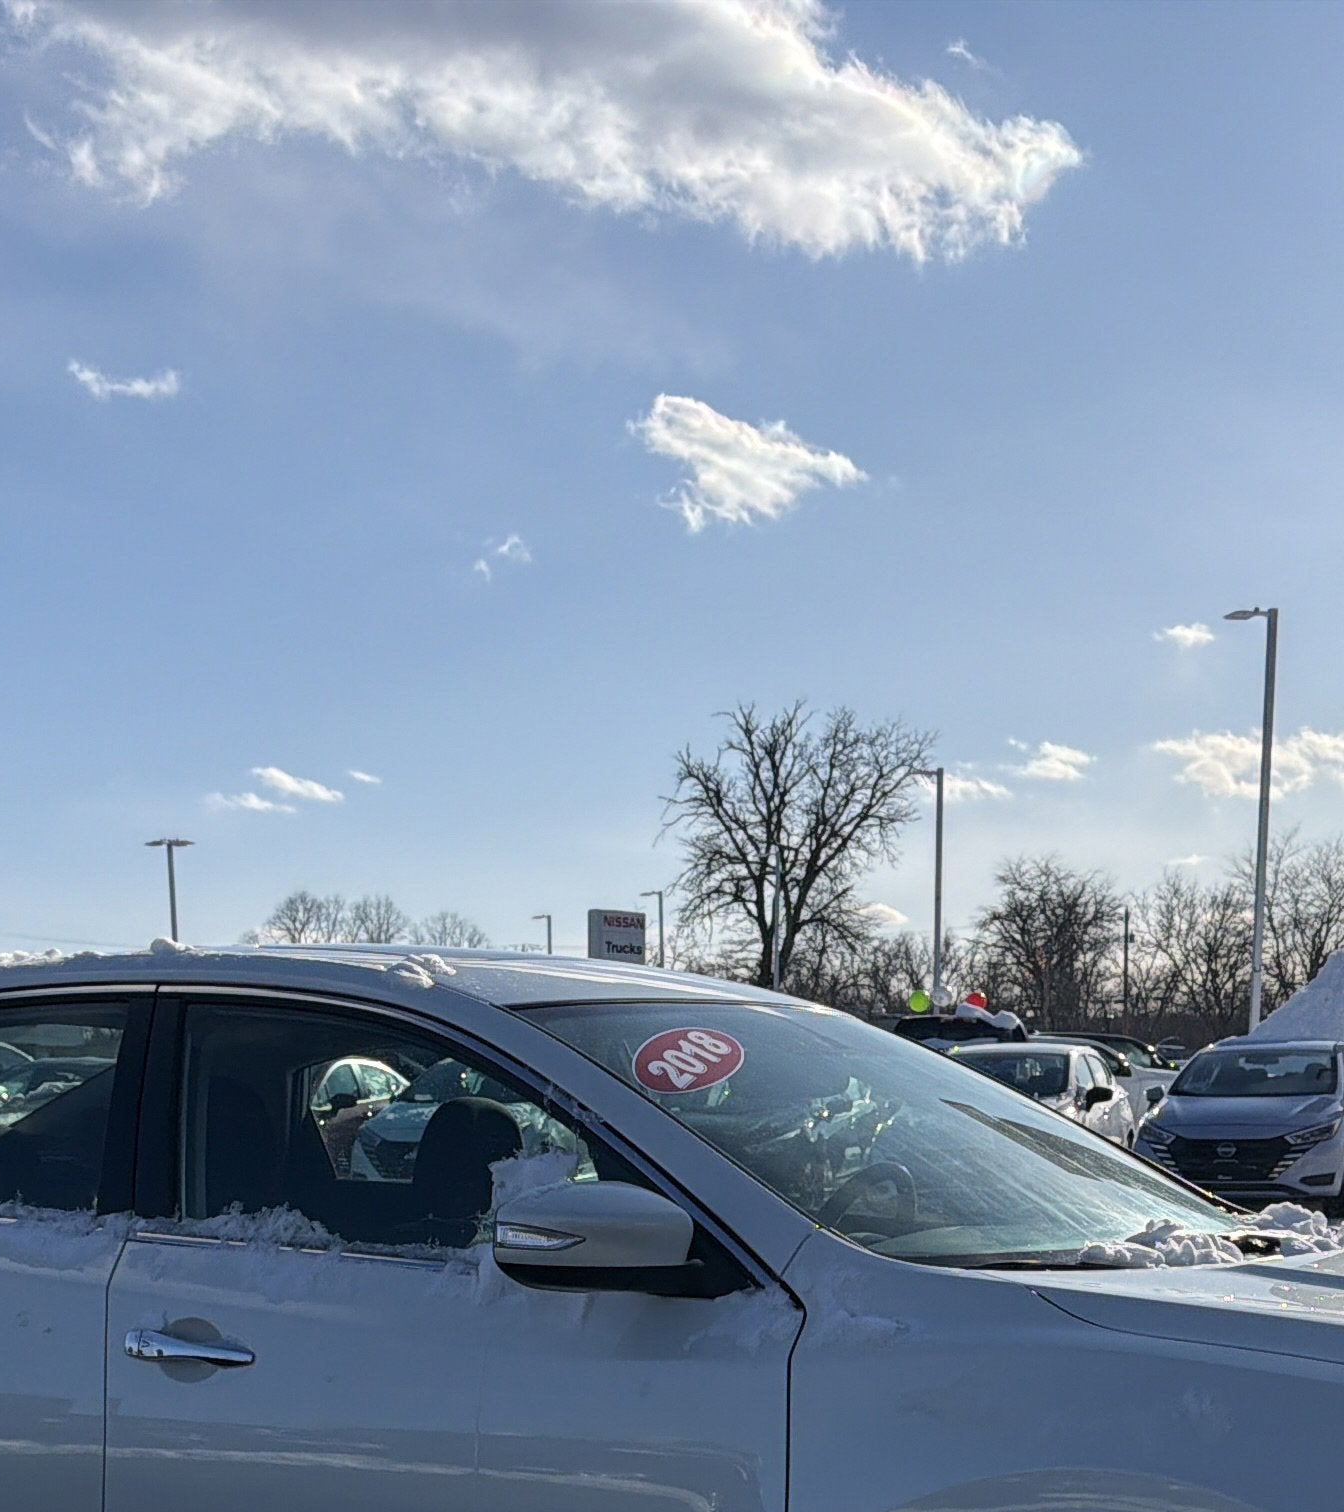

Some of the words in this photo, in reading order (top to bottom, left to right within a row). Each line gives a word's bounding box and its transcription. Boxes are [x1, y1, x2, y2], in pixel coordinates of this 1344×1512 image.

[603, 915, 644, 929] NISSAN
[605, 941, 642, 955] Trucks
[647, 1030, 733, 1090] 2018
